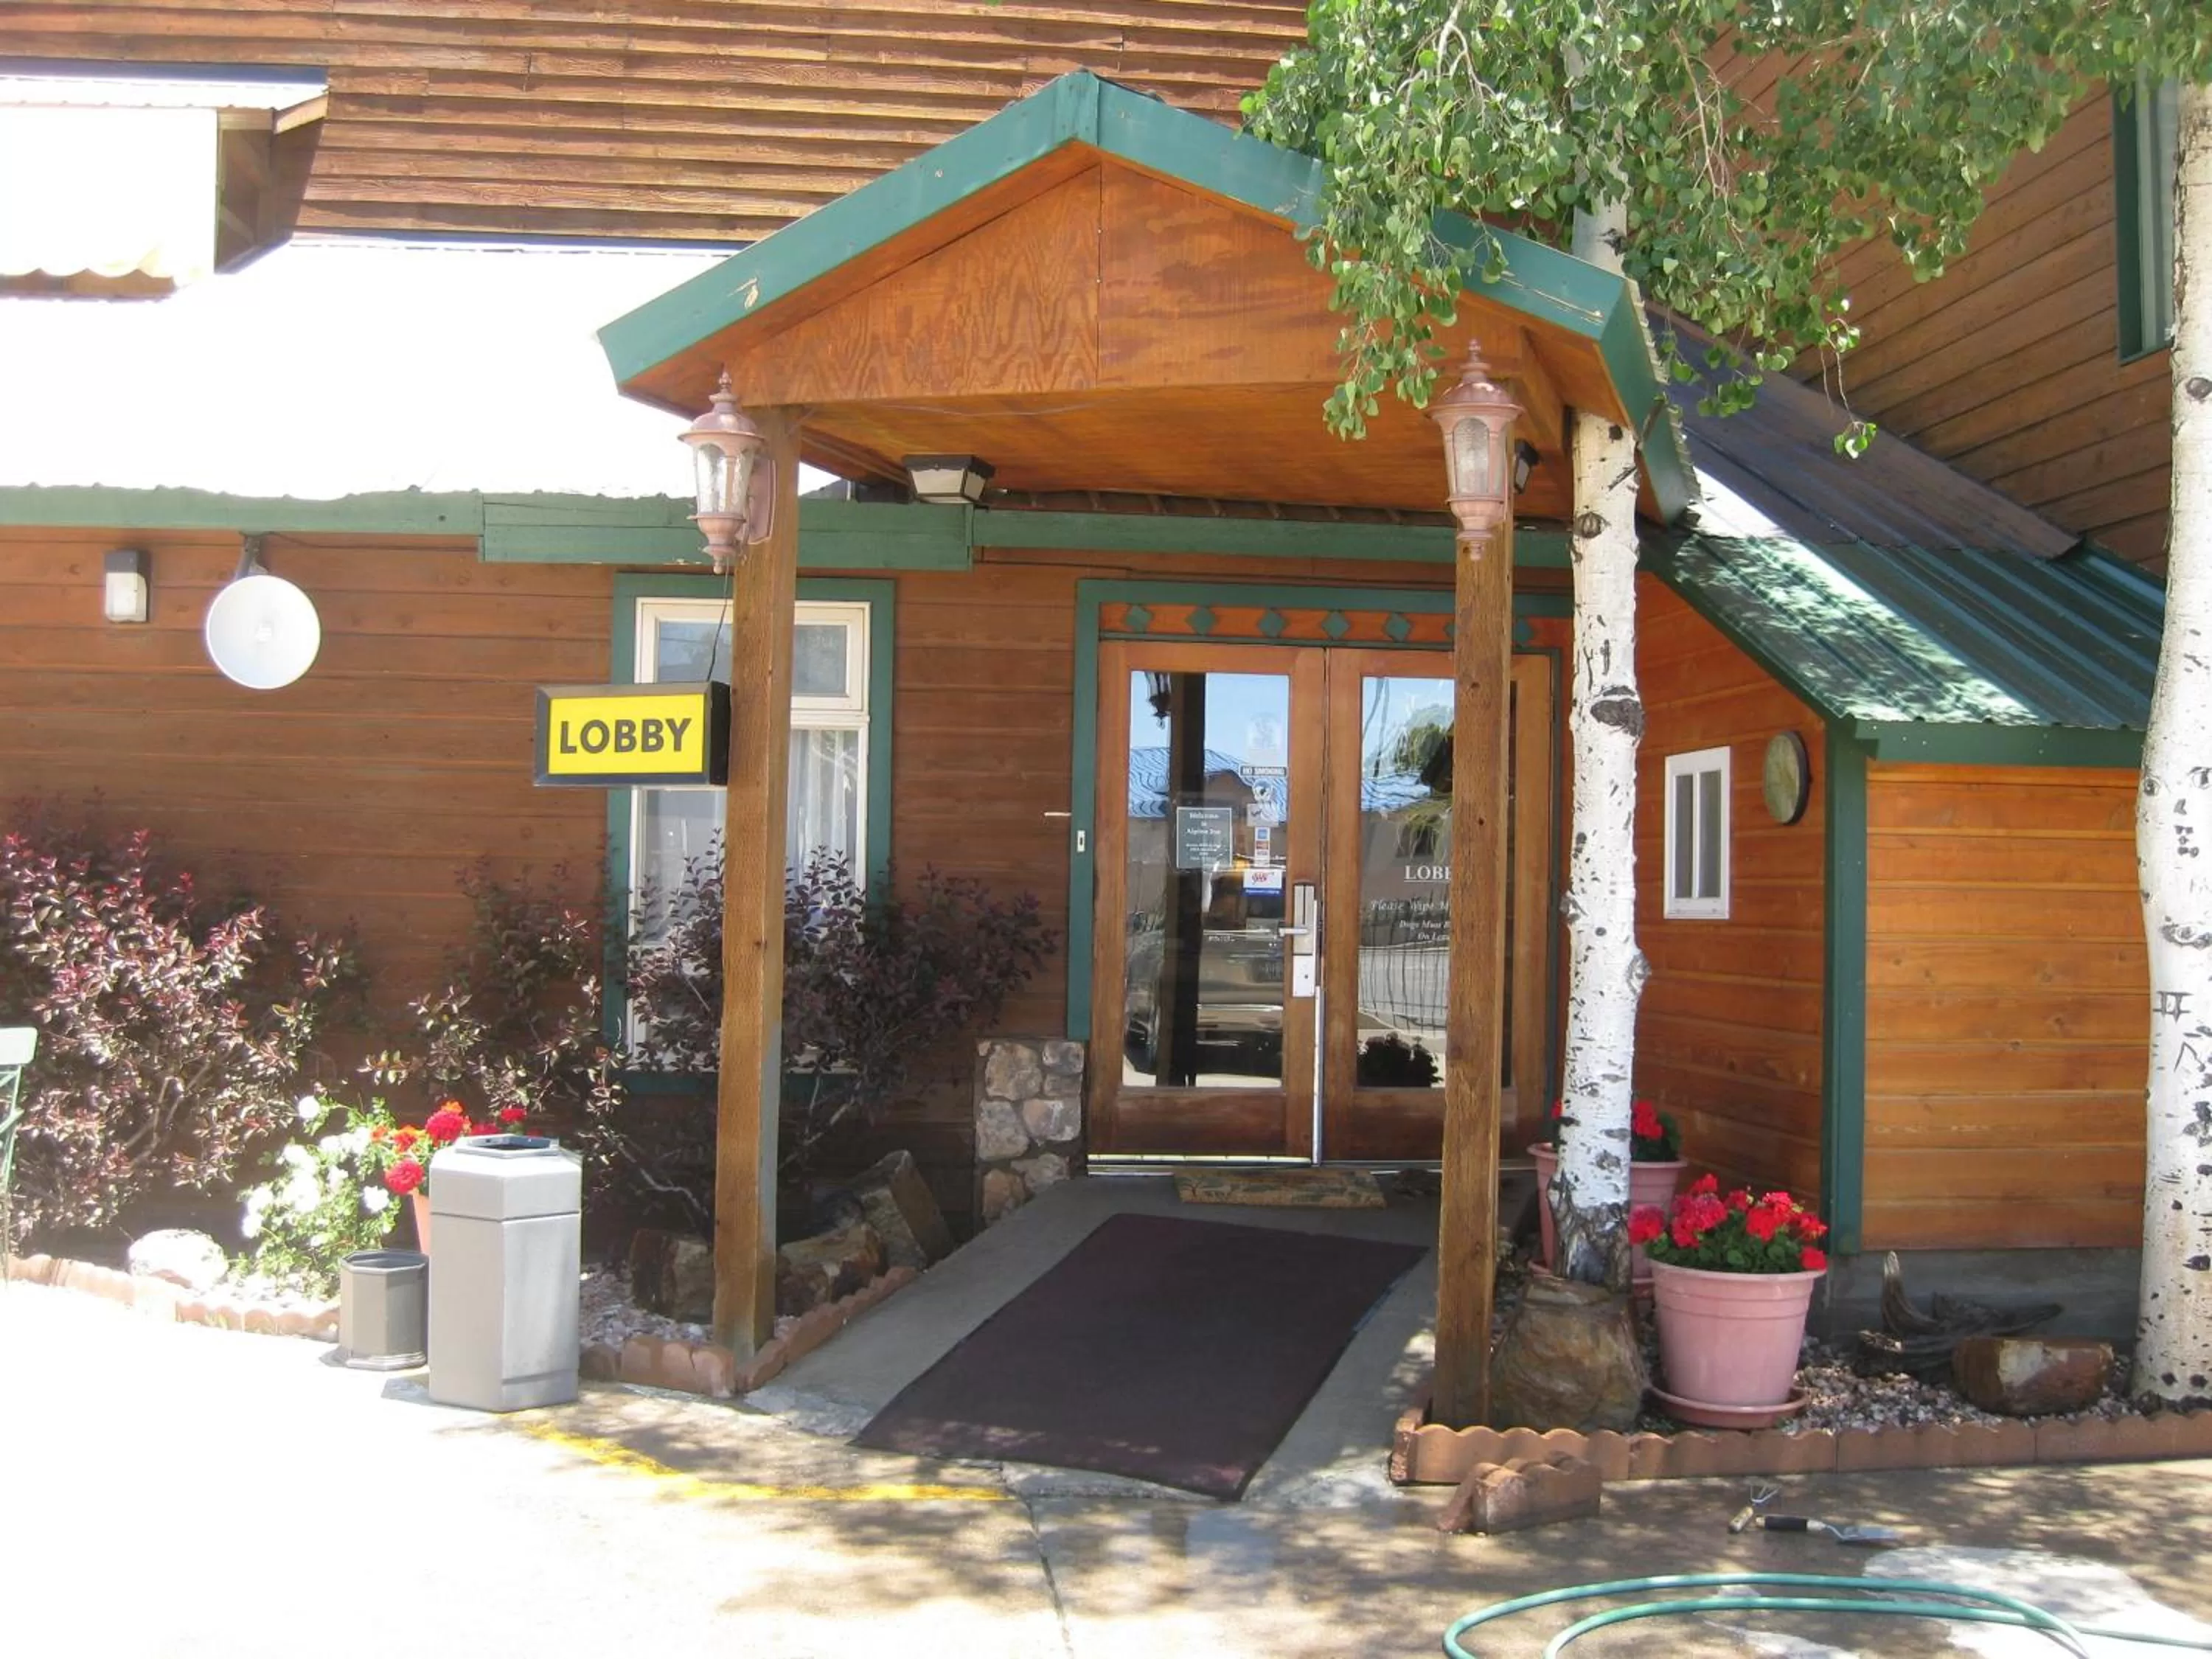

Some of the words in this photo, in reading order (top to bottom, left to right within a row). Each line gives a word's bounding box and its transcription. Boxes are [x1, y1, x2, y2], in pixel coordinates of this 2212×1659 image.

[560, 717, 692, 754] LOBBY
[1371, 899, 1404, 911] Please
[1422, 920, 1441, 928] Must
[1417, 932, 1430, 940] On
